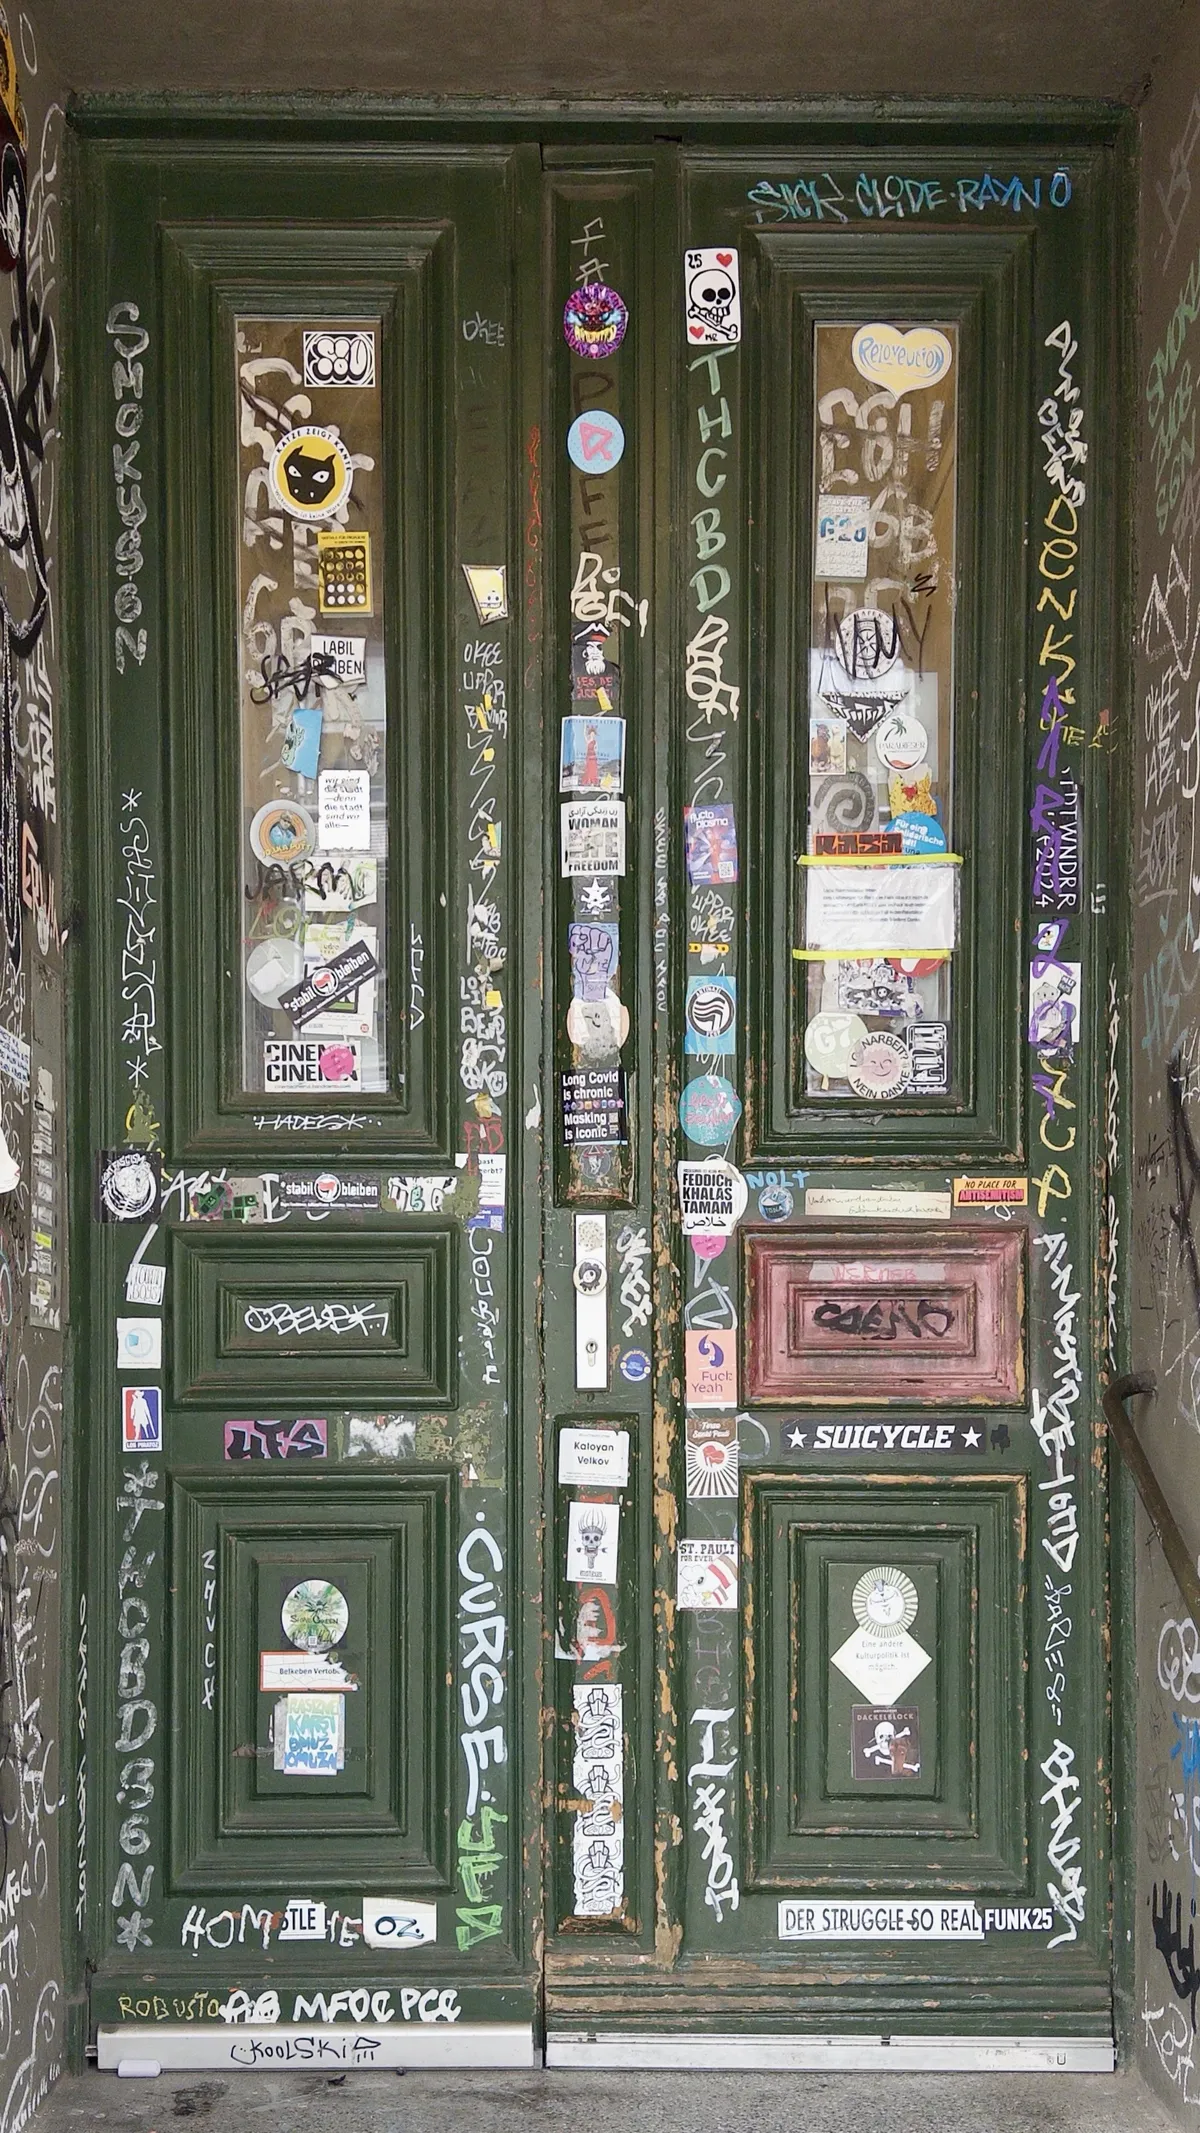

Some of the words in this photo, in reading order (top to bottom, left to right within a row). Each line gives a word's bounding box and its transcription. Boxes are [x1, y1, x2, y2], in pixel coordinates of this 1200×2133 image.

[276, 429, 302, 454] KATZE
[306, 428, 333, 442] ZEIGT
[333, 441, 352, 472] KANTE
[323, 640, 355, 656] LABIL
[568, 817, 618, 830] WOMAN
[696, 818, 729, 830] plasma
[895, 819, 909, 829] Für
[568, 859, 619, 872] FREEDOM
[290, 986, 317, 1012] stabil
[334, 951, 370, 981] bleiben
[563, 1074, 586, 1087] Long
[588, 1071, 619, 1084] Covid
[853, 1077, 877, 1099] NEIN
[881, 1070, 910, 1099] DANKE
[573, 1085, 613, 1099] chronic
[564, 1111, 607, 1127] Masking
[683, 1173, 733, 1187] FEDDICH
[965, 1181, 976, 1189] NO
[977, 1180, 1000, 1189] PLACE
[1003, 1180, 1017, 1189] FOR
[286, 1182, 314, 1195] stabil
[341, 1182, 378, 1197] bleiben
[683, 1187, 733, 1201] KHALAS
[958, 1189, 1024, 1203] ANTISEMITISM
[683, 1200, 733, 1214] TAMAM
[686, 1216, 726, 1230] خلاص
[702, 1370, 733, 1382] Fuck
[691, 1383, 723, 1393] Yeah
[813, 1425, 957, 1449] SUICYCLE
[574, 1441, 614, 1453] Kaloyan
[577, 1456, 610, 1466] Velkov
[680, 1543, 699, 1555] ST.
[700, 1543, 736, 1556] PAULI
[856, 1652, 899, 1660] Kulturpolitik
[458, 1527, 508, 1818] CURSE
[857, 1713, 914, 1722] DACKELBLOCK
[785, 1908, 815, 1931] DER
[822, 1907, 904, 1931] STRUGGLE
[911, 1908, 934, 1931] SO
[941, 1907, 981, 1931] REAL
[985, 1907, 1053, 1931] FUNK25
